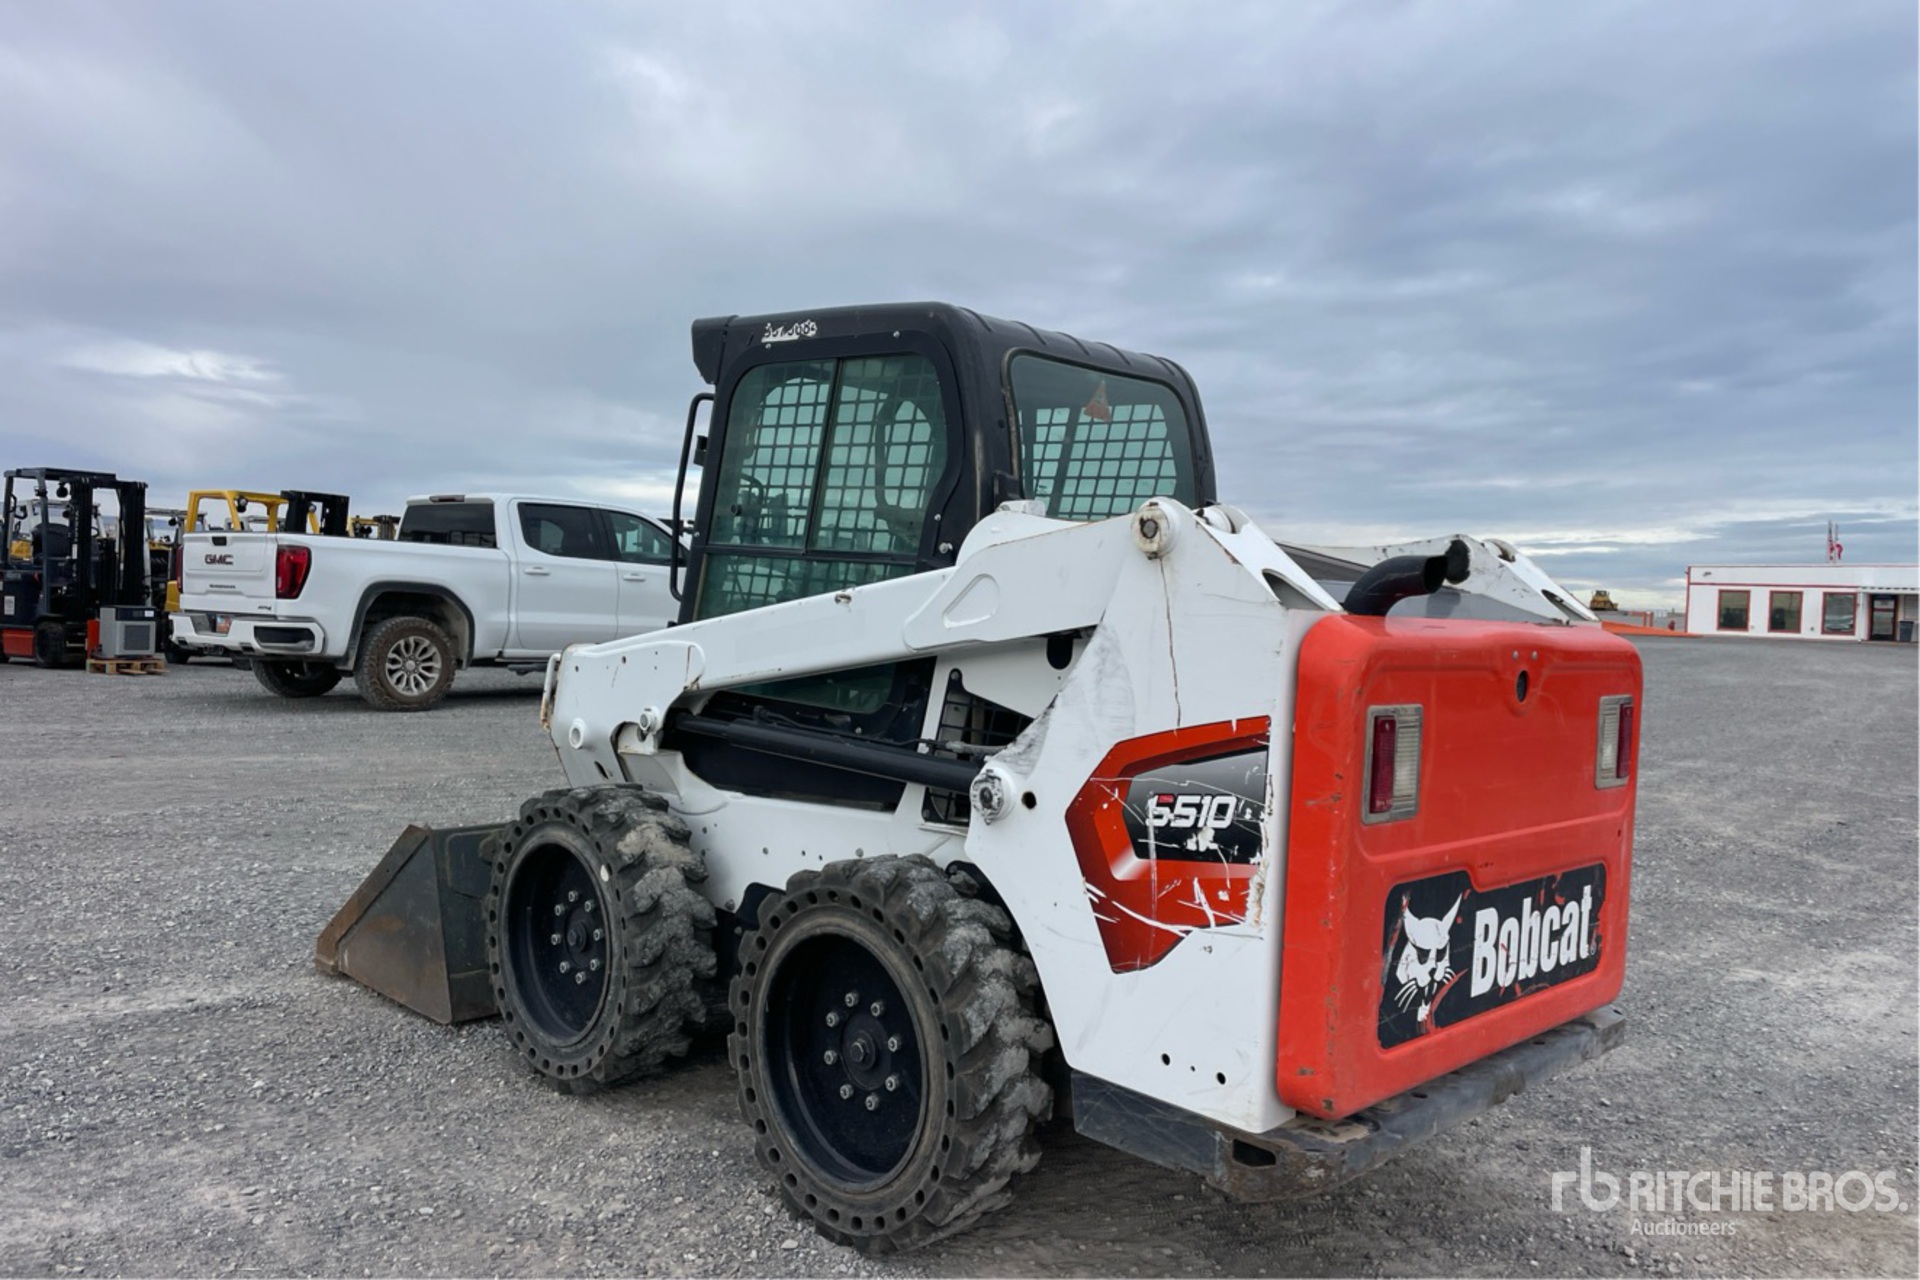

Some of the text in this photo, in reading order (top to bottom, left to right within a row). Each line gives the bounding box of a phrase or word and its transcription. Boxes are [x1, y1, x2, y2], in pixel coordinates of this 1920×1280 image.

[205, 554, 234, 565] GMC
[1146, 794, 1237, 829] S510
[1471, 885, 1592, 998] Bobcat
